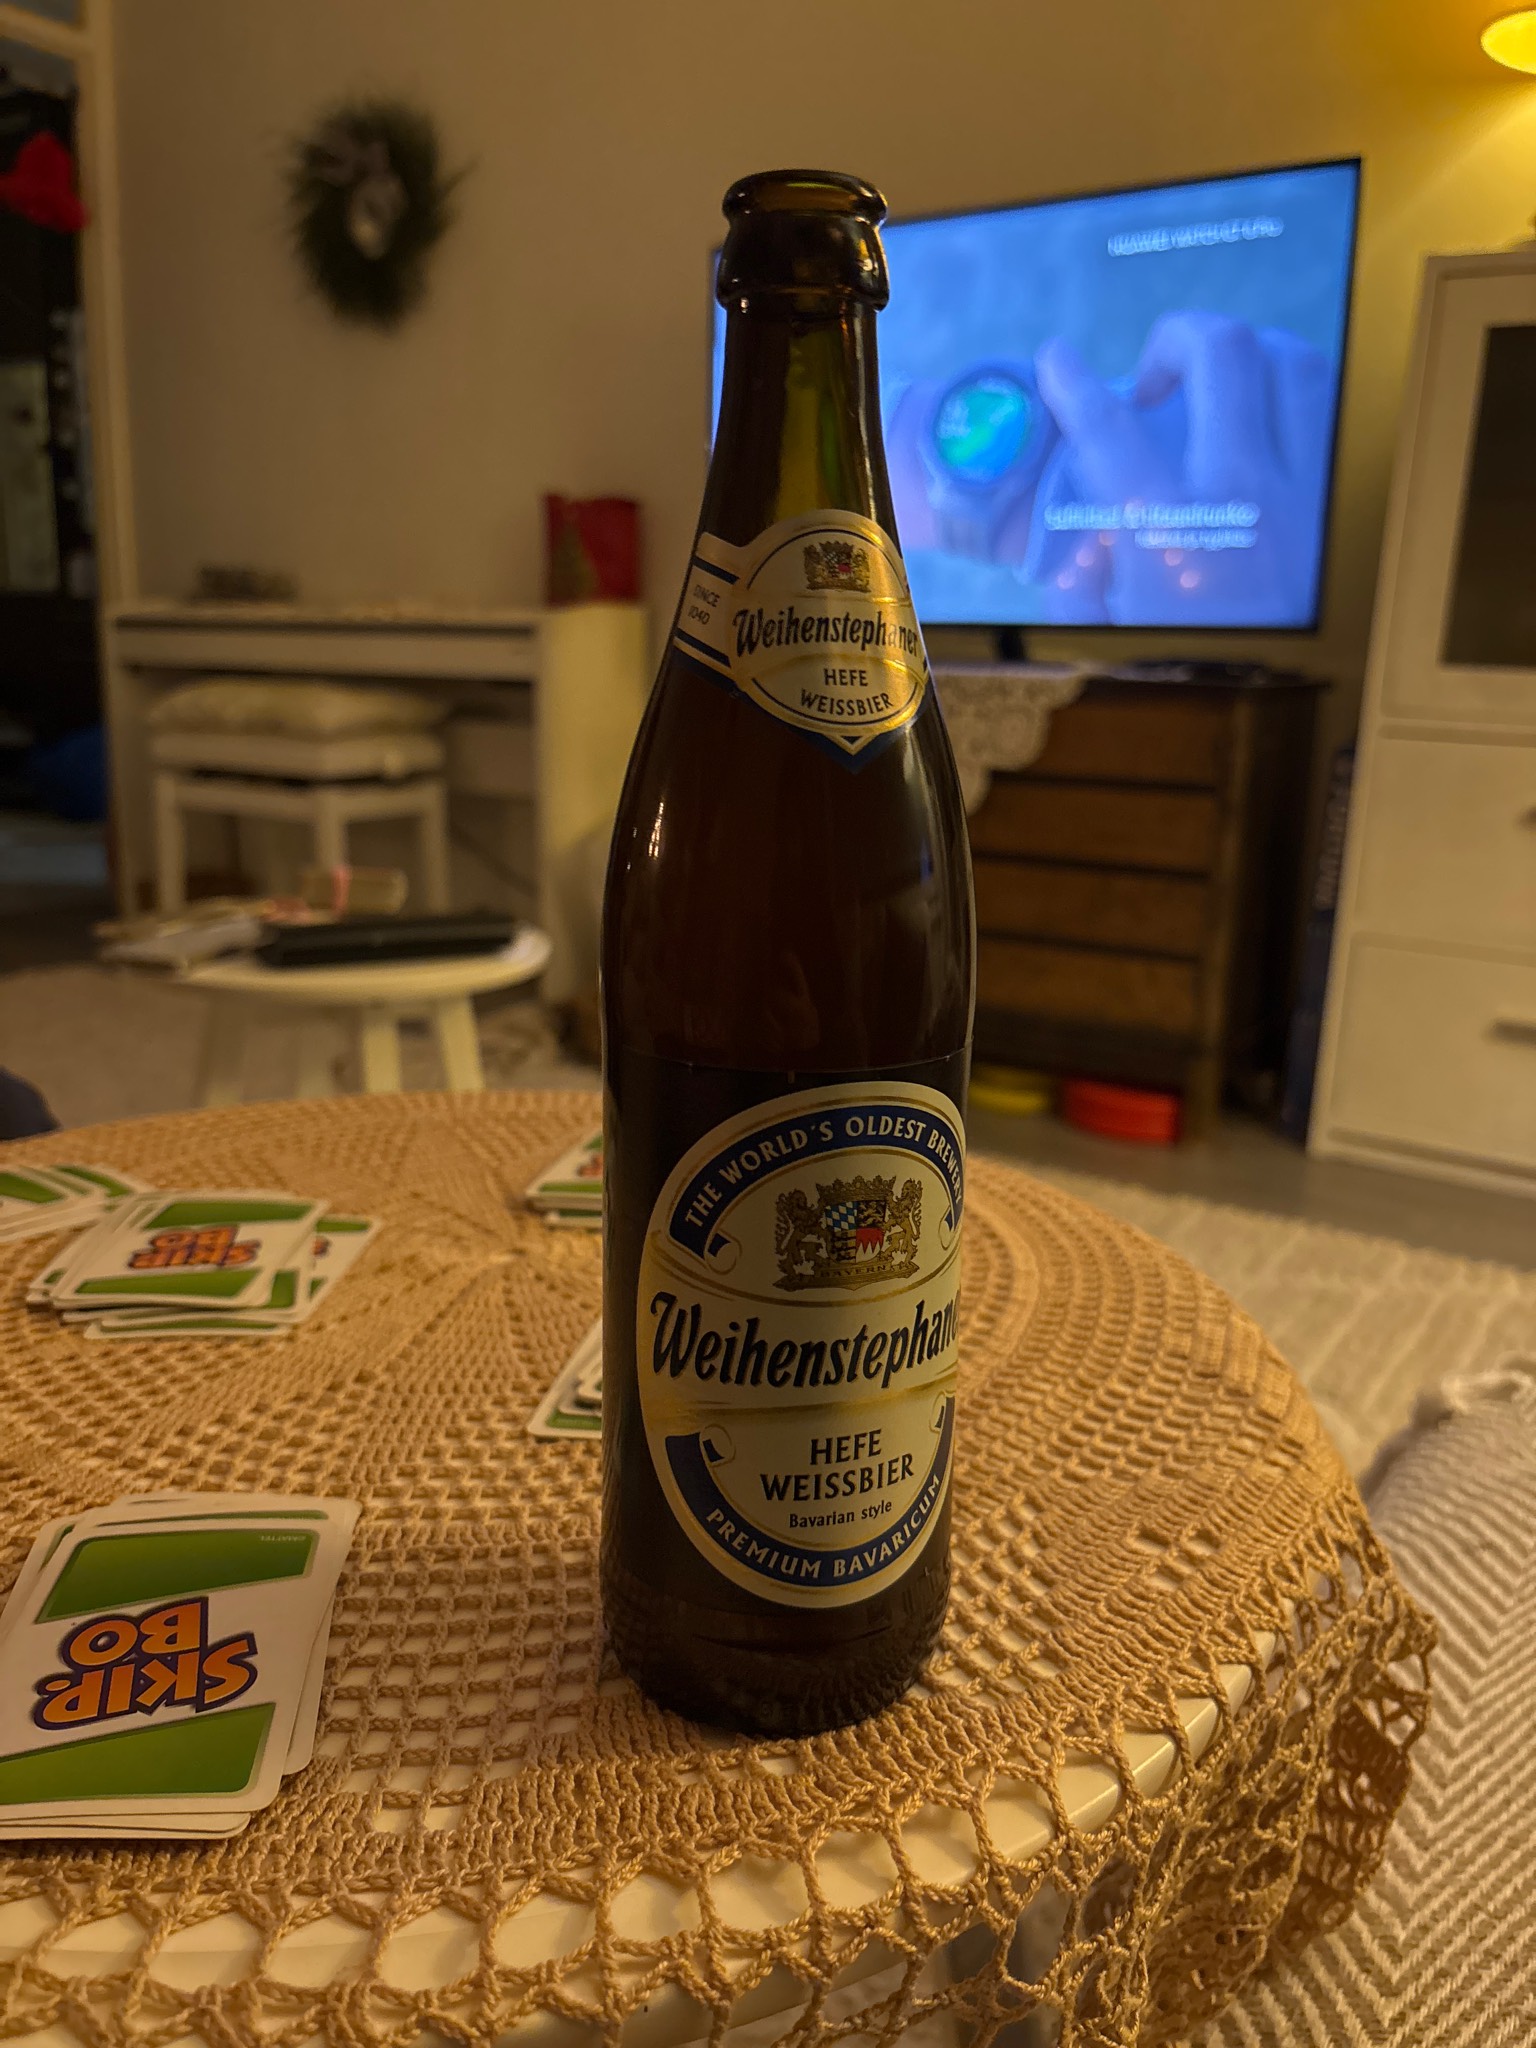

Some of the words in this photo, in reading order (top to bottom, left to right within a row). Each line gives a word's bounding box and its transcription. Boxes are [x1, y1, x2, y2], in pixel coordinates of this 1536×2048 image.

[732, 606, 918, 657] Weihenstephaner
[823, 668, 868, 687] HEFE
[800, 689, 893, 716] WEISSBIER
[685, 1183, 723, 1228] THE
[719, 1121, 834, 1185] WORLD'S
[845, 1116, 926, 1143] OLDEST
[927, 1129, 962, 1204] BREWERY
[809, 1428, 882, 1465] HEFE
[760, 1453, 914, 1501] WEISSBIER
[706, 1508, 821, 1578] PREMIUM
[832, 1474, 941, 1577] BAVARICUM
[788, 1511, 856, 1528] Bavarian
[861, 1499, 892, 1521] style
[60, 1595, 209, 1671] BO
